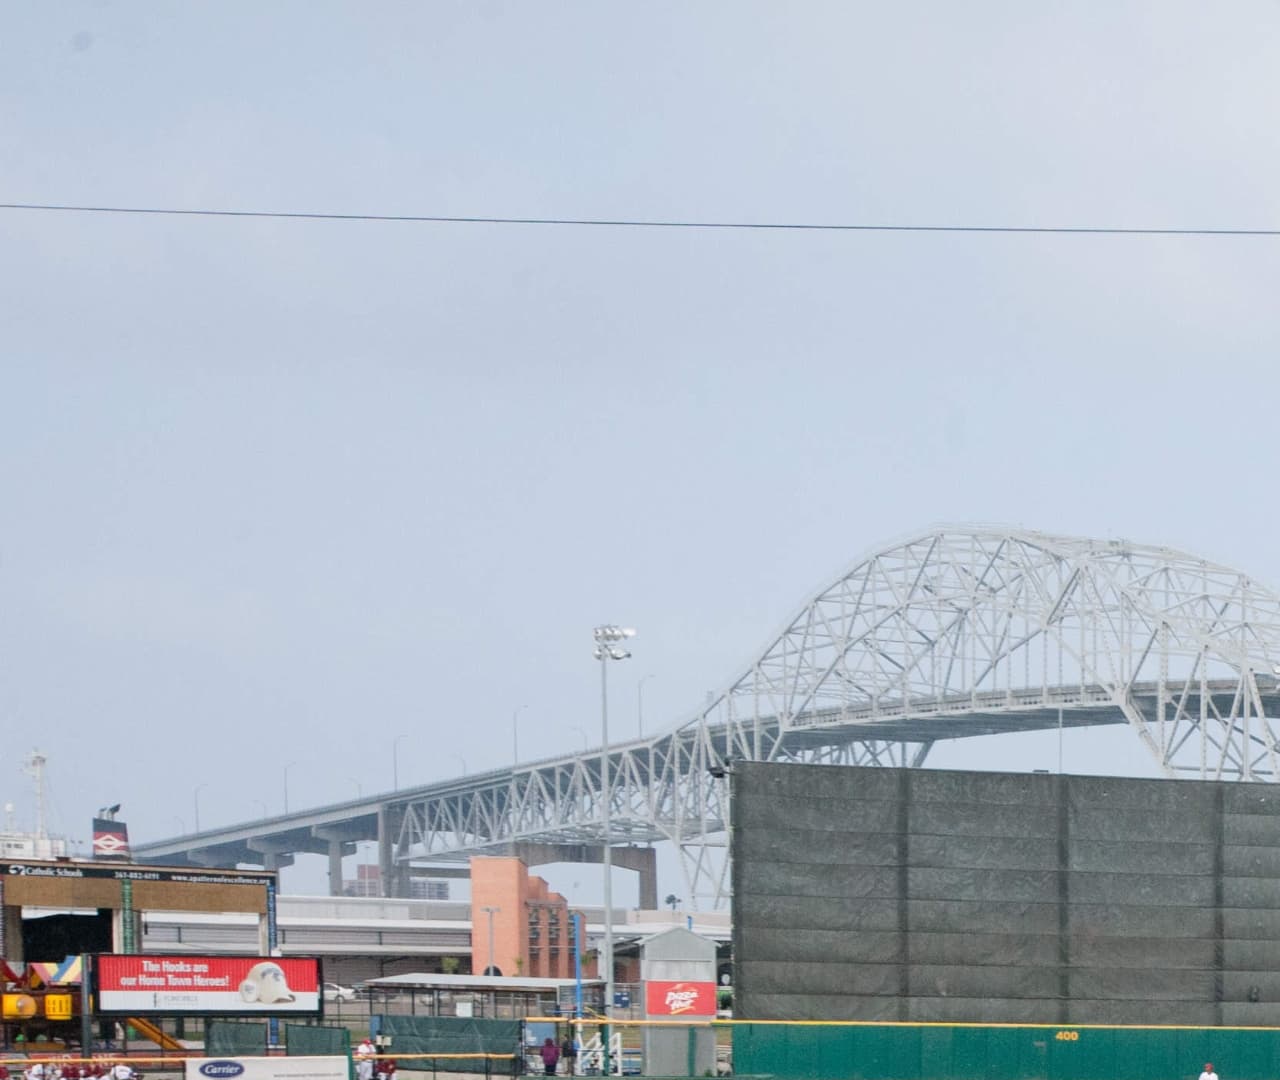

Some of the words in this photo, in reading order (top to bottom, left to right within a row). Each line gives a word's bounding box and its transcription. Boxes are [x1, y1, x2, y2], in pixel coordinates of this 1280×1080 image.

[142, 961, 160, 972] The
[162, 961, 191, 972] Hooks
[193, 964, 208, 972] are
[121, 977, 136, 986] our
[139, 974, 165, 986] Home
[167, 974, 192, 986] Town
[194, 975, 229, 986] Heroes!
[1056, 1031, 1078, 1040] 400
[205, 1064, 240, 1074] Carrier
